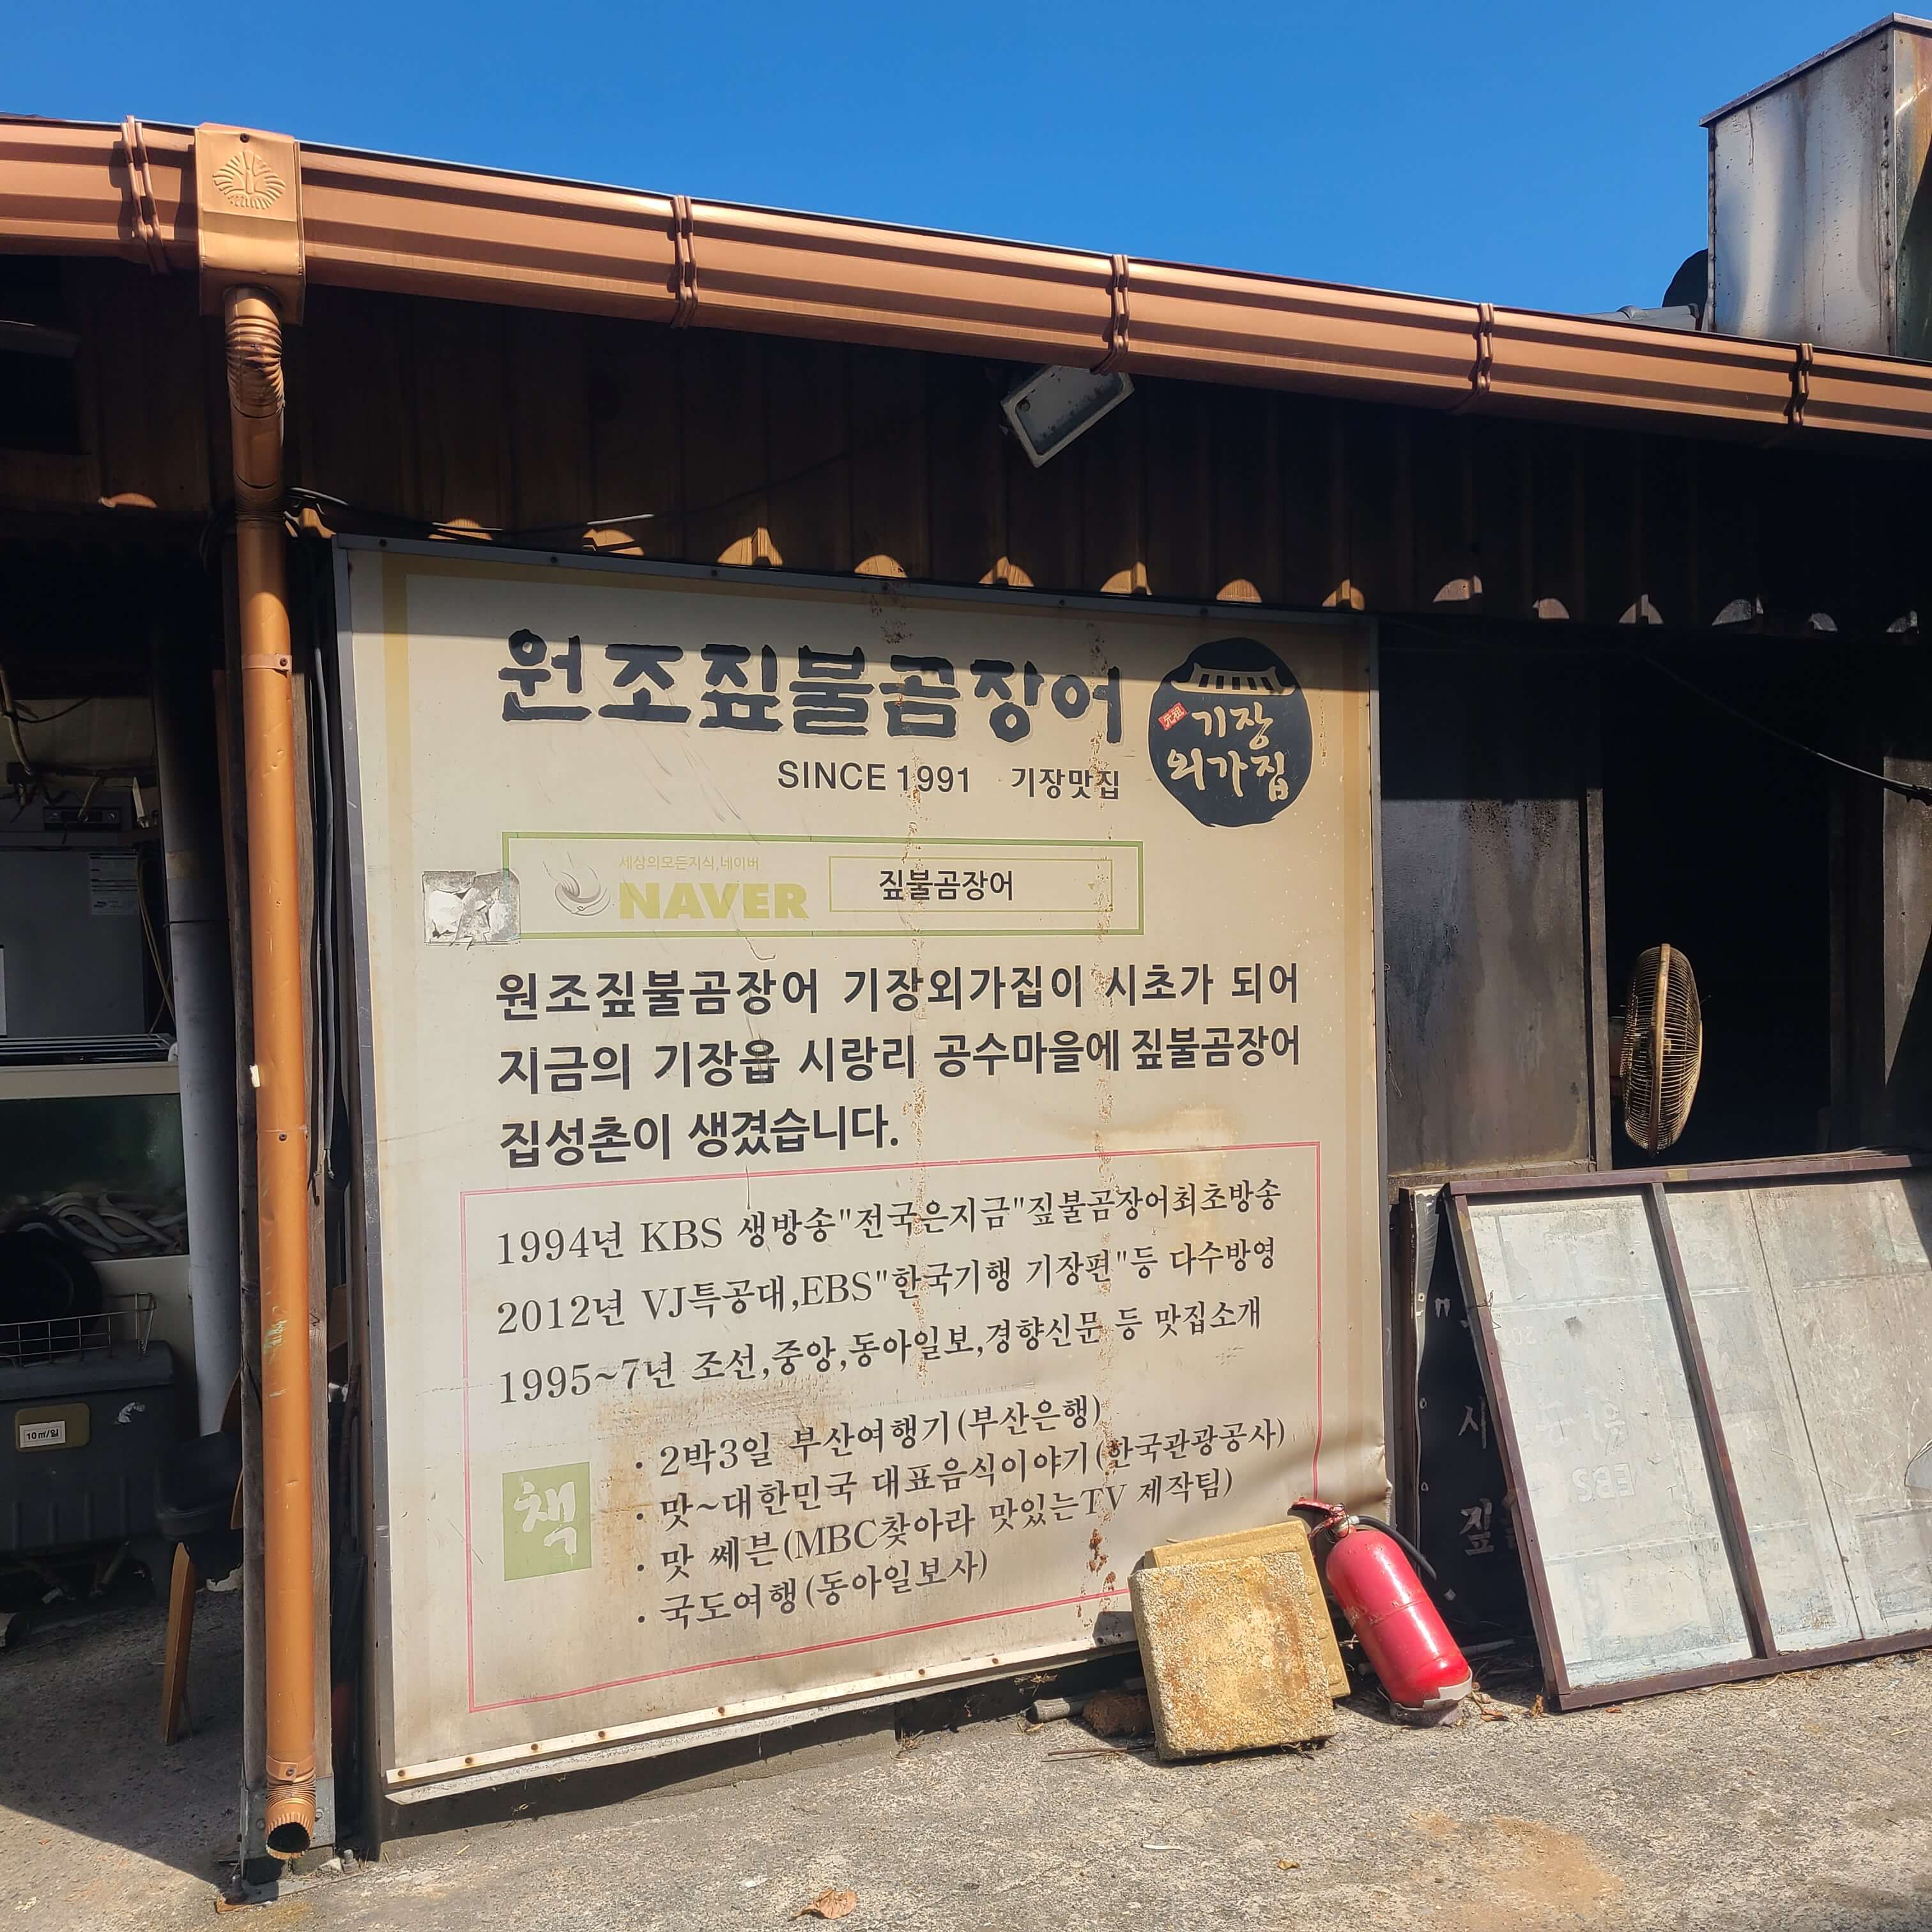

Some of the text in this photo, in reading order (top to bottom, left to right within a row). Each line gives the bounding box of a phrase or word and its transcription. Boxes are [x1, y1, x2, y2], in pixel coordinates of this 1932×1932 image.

[498, 629, 1123, 744] 원조짚불곰장어
[1191, 702, 1273, 750] 기장
[777, 760, 1120, 799] SINCE 1991 기장맛집
[1167, 747, 1289, 802] 외가집
[619, 882, 809, 919] NAVER
[878, 870, 1013, 902] 짚불곰장어
[496, 963, 1297, 1020] 원조짚불곰장어 기장외가집이 시초가 되어
[498, 1025, 1300, 1094] 지금의 기장읍 시랑리 공수마을에 짚불곰장어
[500, 1104, 899, 1168] 집성촌이 생겼습니다.
[497, 1221, 624, 1265] 1994년
[640, 1217, 723, 1253] KBS
[498, 1289, 625, 1334] 2012년
[1169, 1237, 1275, 1276] 다수방영
[500, 1352, 675, 1404] 1995~7년
[1115, 1308, 1143, 1341] 등
[1155, 1296, 1261, 1339] 맛집소개
[659, 1431, 772, 1476] 2박3일
[513, 1480, 578, 1564] 책
[660, 1542, 694, 1584] 맛
[989, 1482, 1128, 1534] 맛있는TV
[1136, 1467, 1233, 1507] 제작팀)
